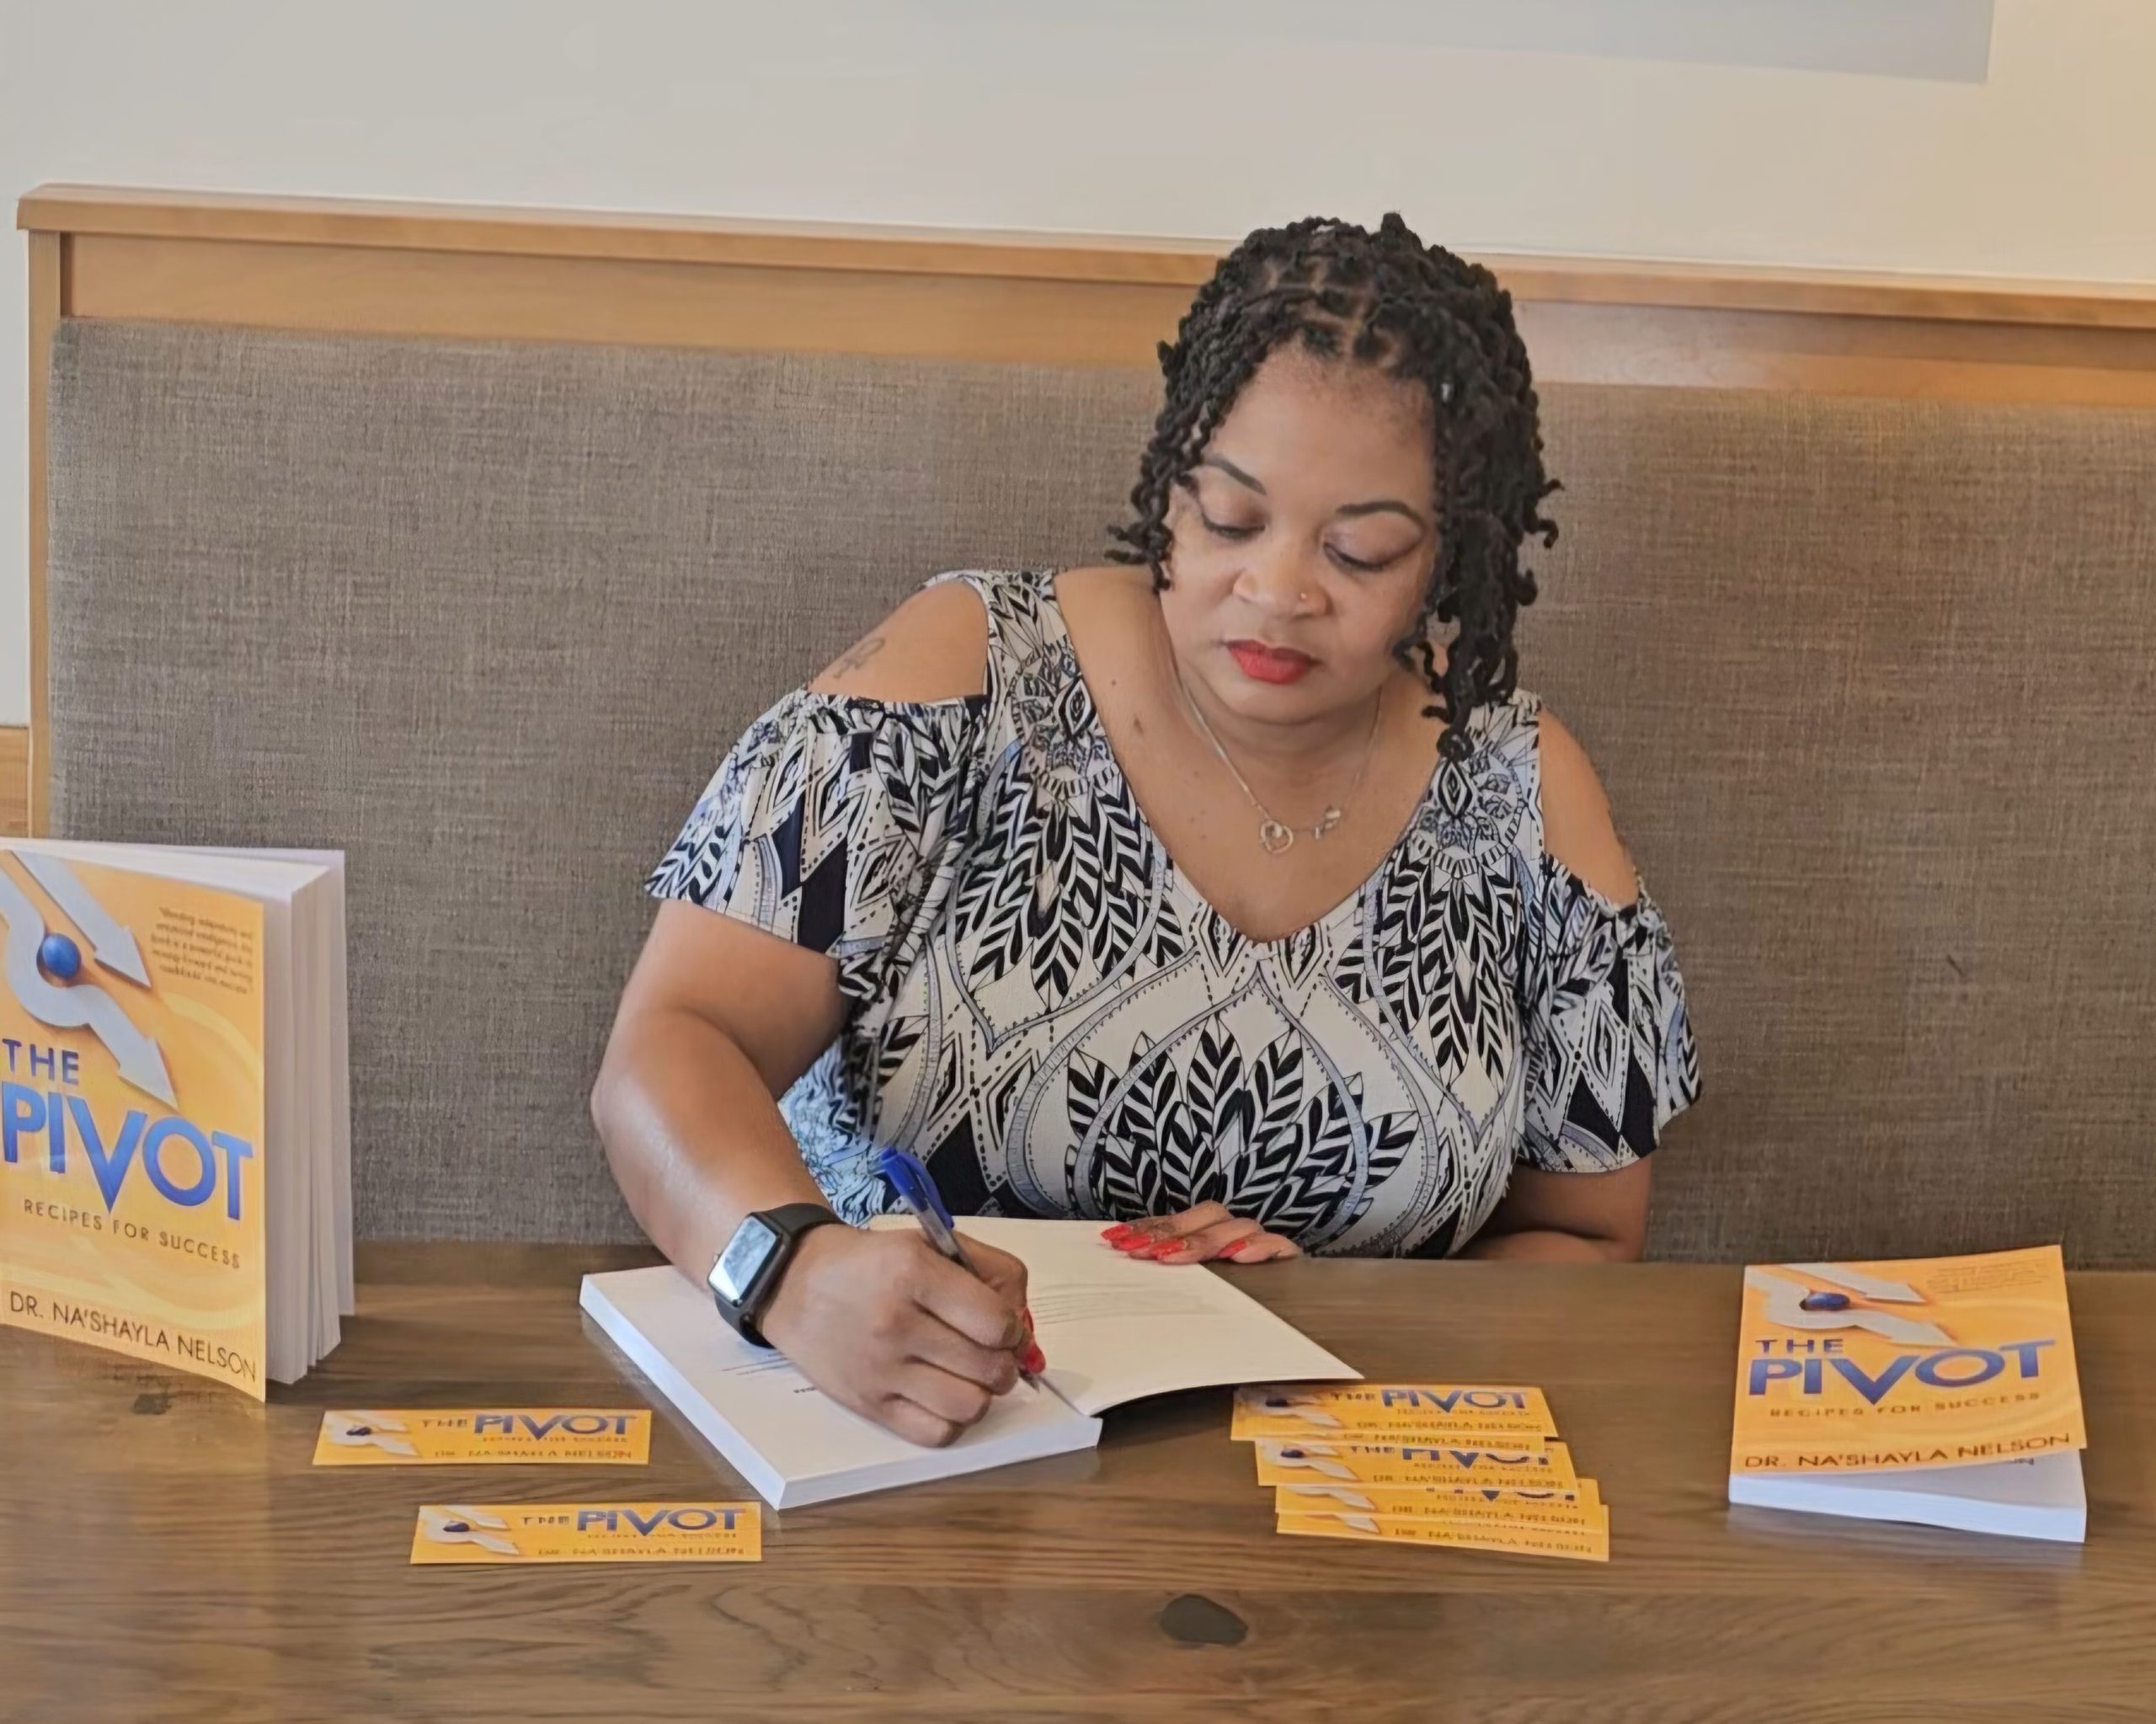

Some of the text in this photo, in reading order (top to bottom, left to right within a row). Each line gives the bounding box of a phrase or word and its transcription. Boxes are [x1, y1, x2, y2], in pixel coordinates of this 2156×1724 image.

[2, 1038, 79, 1086] THE
[2, 1081, 253, 1220] PIVOT
[24, 1199, 240, 1268] RECIPES FOR SUCCESS
[10, 1291, 256, 1381] DR. NA'SHAYLA NELSON
[1755, 1338, 1844, 1353] THE
[1748, 1340, 2056, 1405] PIVOT
[1381, 1389, 1528, 1412] PIVOT
[1769, 1392, 2041, 1417] RECIPES FOR SUCCESS
[474, 1414, 637, 1440] PIVOT
[1745, 1433, 2070, 1468] DR. NA'SHAYLA NELSON
[577, 1508, 746, 1536] PIVOT
